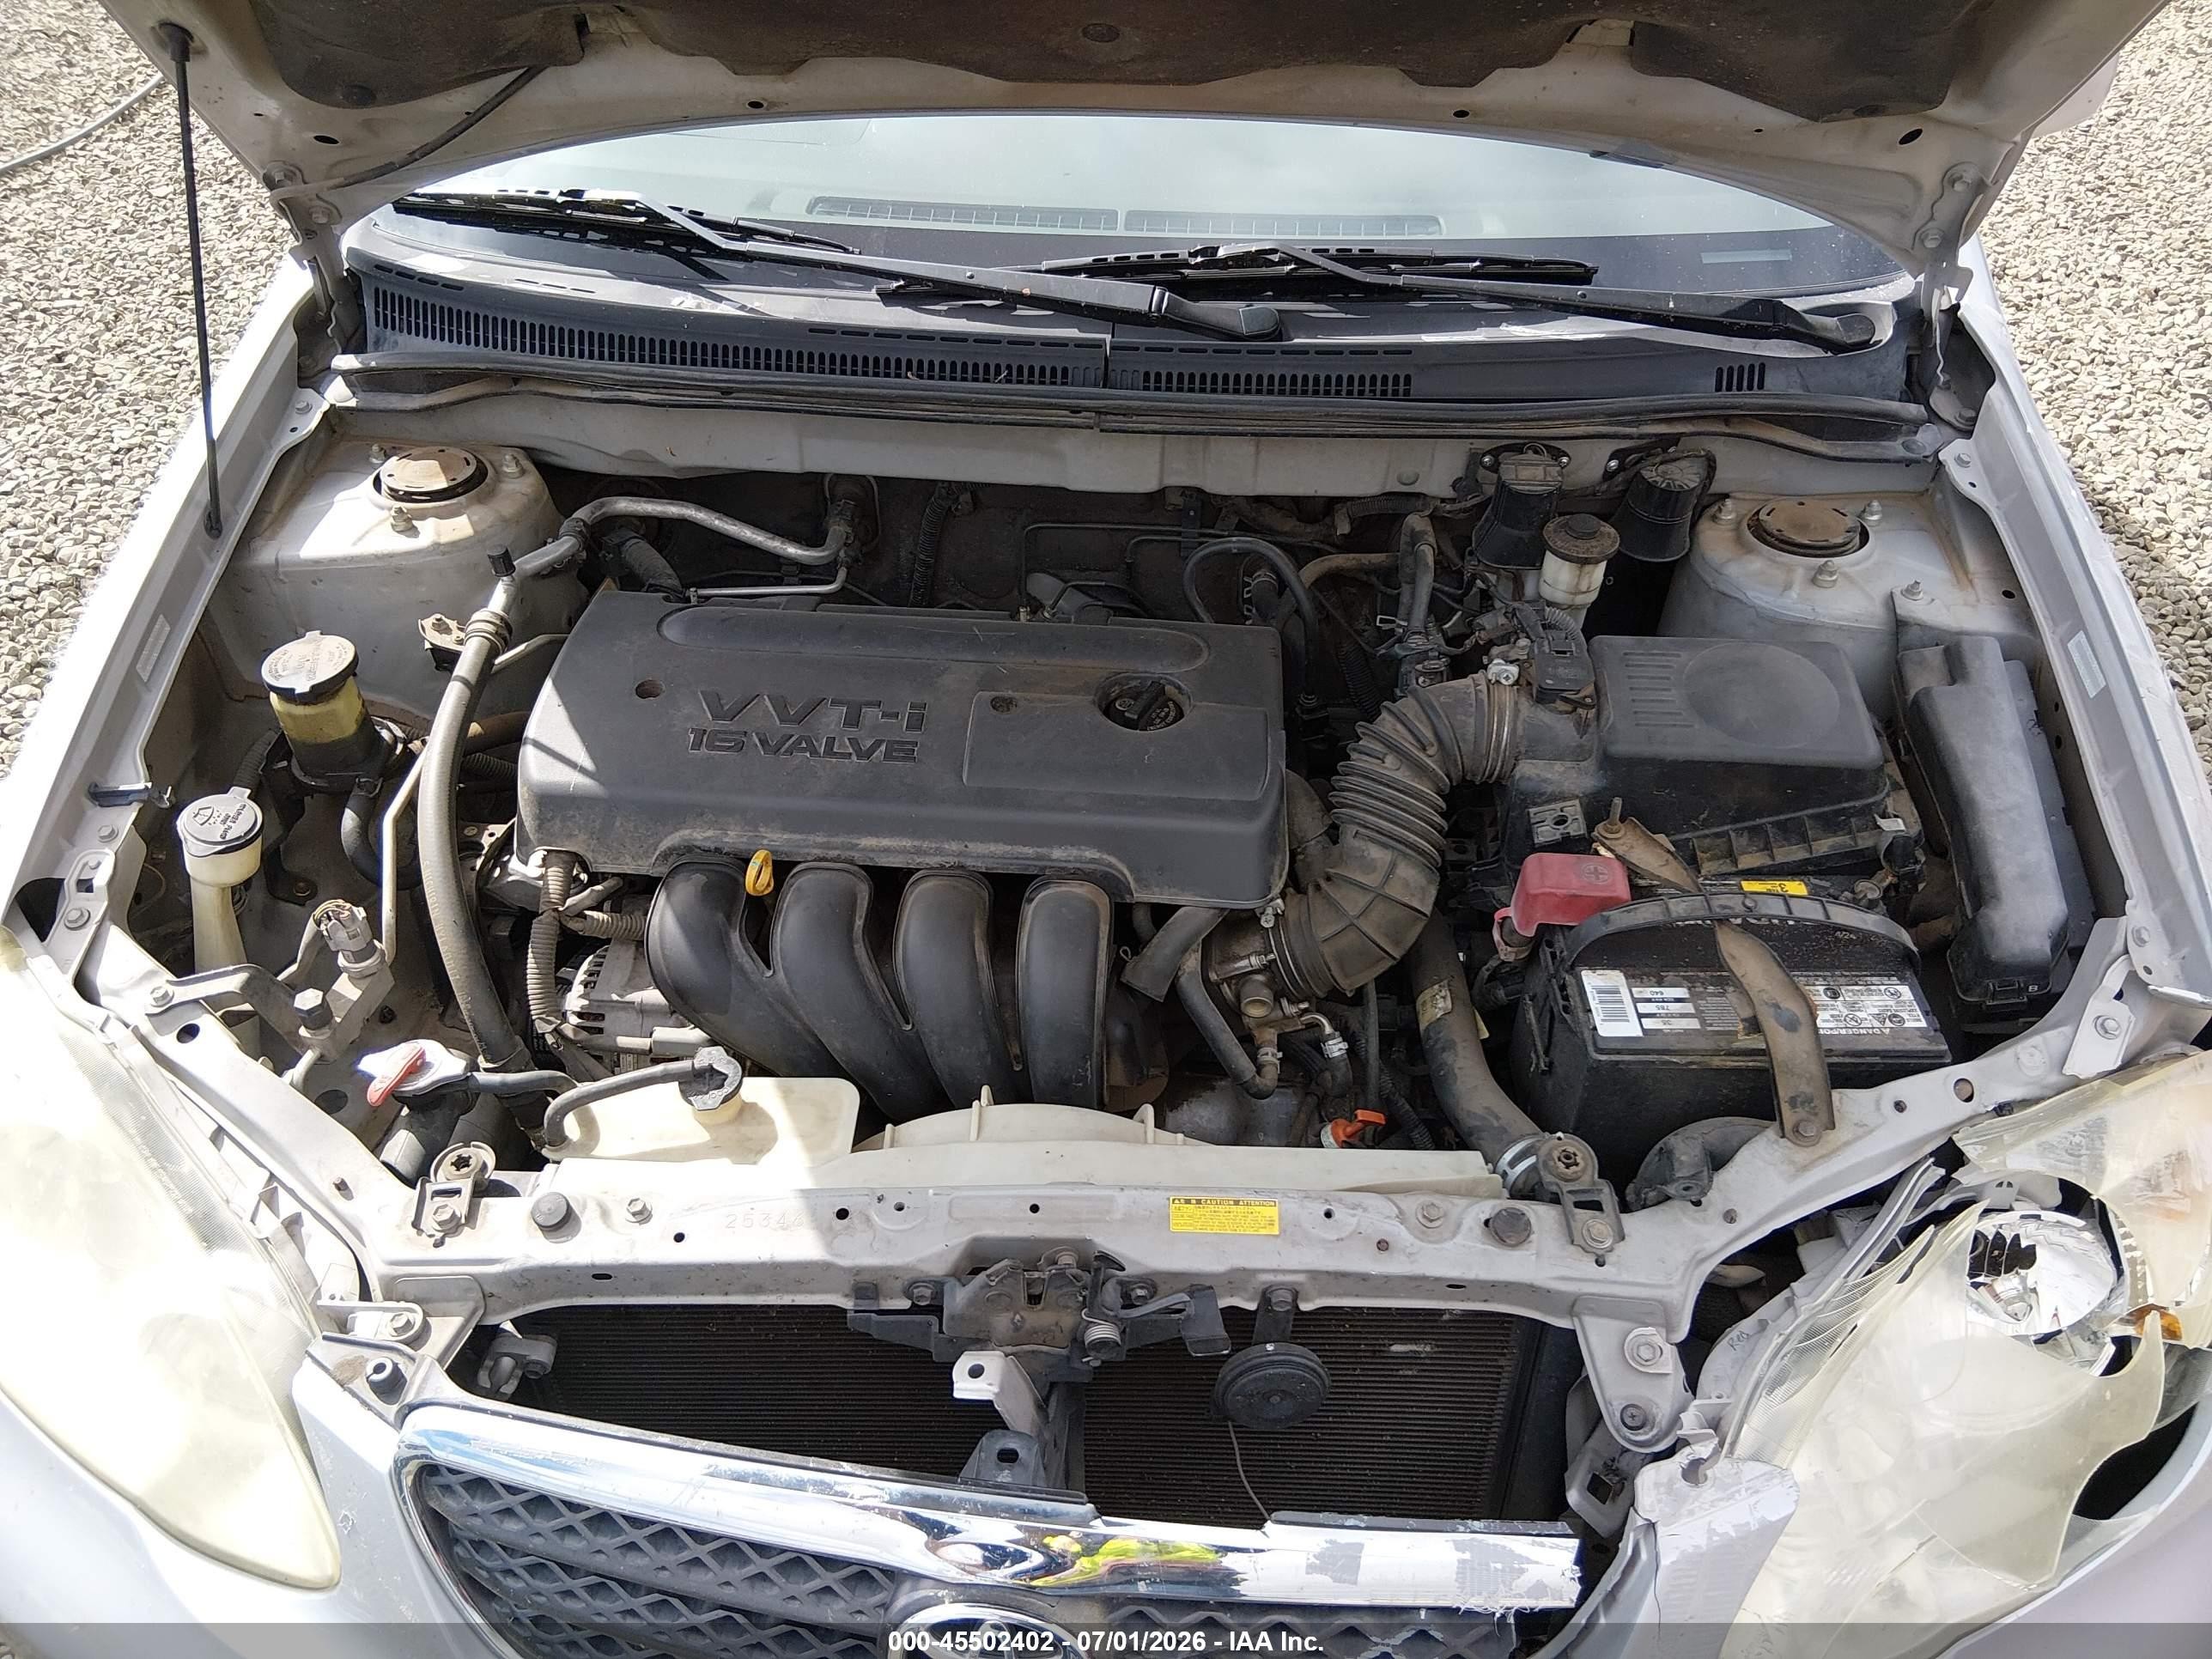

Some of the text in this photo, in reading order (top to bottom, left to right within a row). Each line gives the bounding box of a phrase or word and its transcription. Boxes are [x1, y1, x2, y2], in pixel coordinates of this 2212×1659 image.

[698, 690, 928, 733] VVT-i
[688, 727, 920, 763] 16 VALVE
